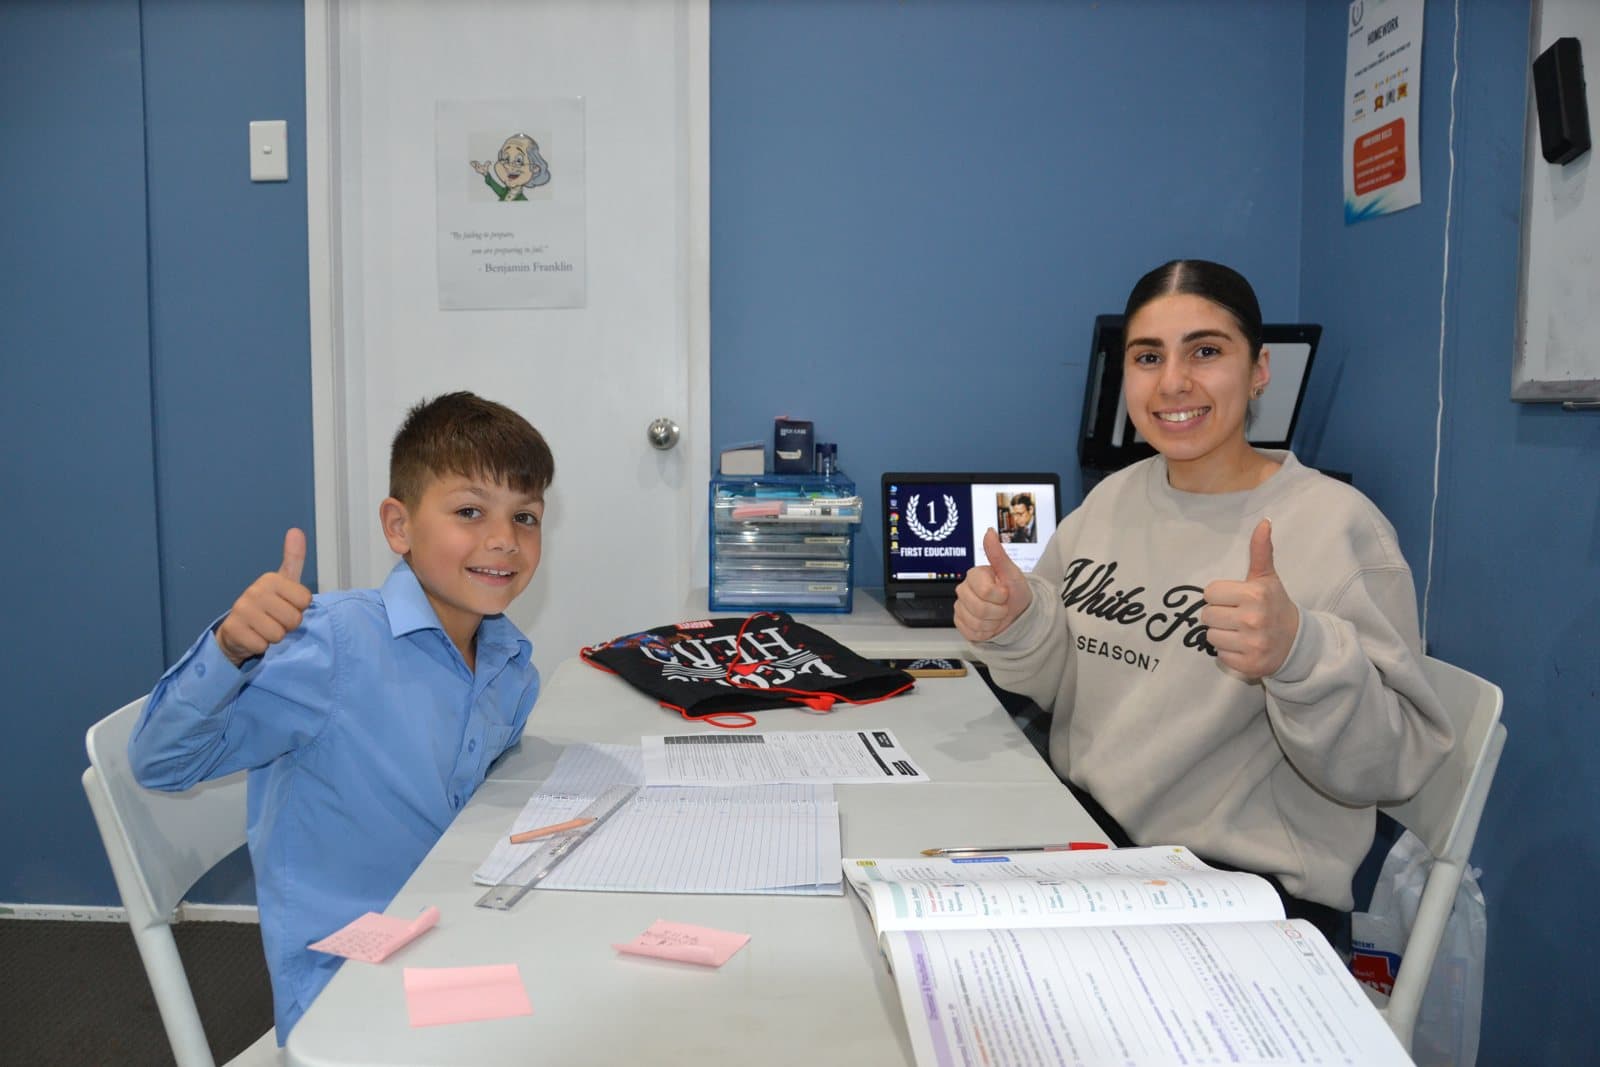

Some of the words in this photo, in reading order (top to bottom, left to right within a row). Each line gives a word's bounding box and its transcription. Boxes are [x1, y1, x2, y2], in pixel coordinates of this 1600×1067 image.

[1367, 15, 1399, 46] HOMEWORK
[485, 263, 530, 275] Benjamin
[533, 260, 573, 272] Franklin
[900, 547, 922, 557] FIRST
[924, 547, 967, 557] EDUCATION
[1061, 558, 1147, 625] White
[1076, 635, 1150, 670] SEASON
